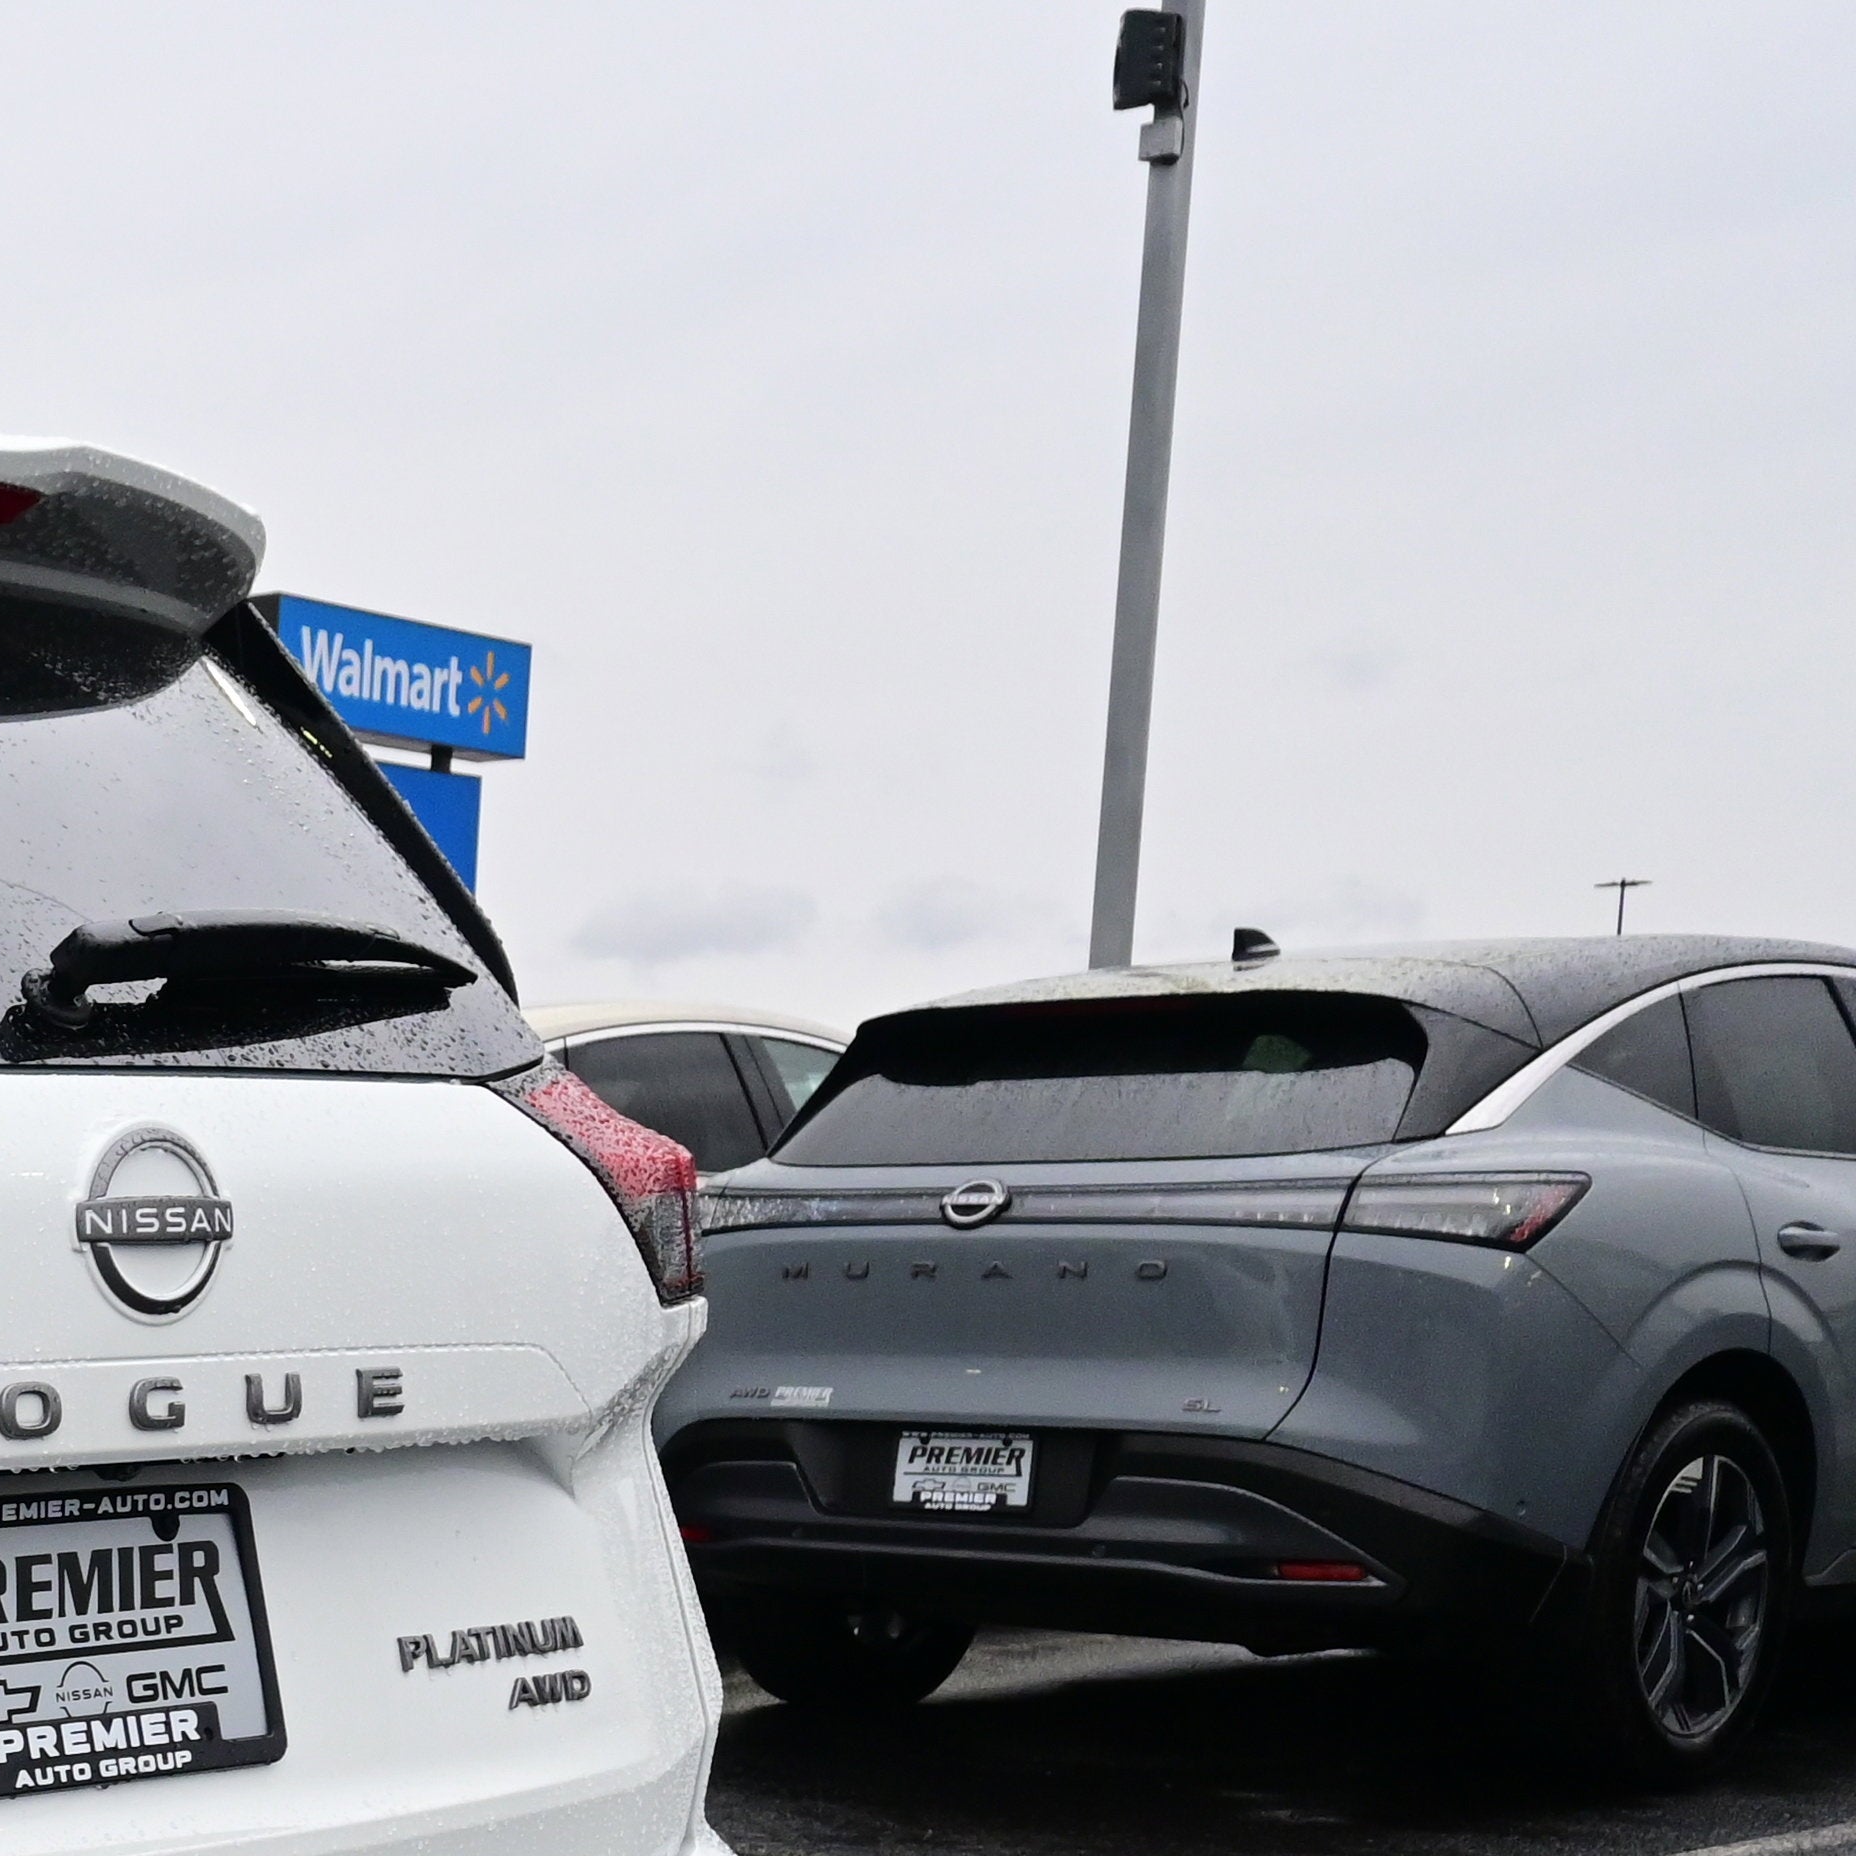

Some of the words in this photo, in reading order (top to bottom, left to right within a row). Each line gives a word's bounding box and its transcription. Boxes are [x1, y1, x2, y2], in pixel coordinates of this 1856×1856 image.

[301, 625, 463, 717] Walmart
[84, 1207, 231, 1235] NISSAN
[781, 1260, 1168, 1281] MURANO
[908, 1446, 1026, 1475] PREMIER
[920, 1491, 997, 1505] PREMIER
[977, 1482, 1017, 1493] GMC
[68, 1615, 184, 1644] GROUP
[397, 1615, 585, 1673] PLATINUM
[56, 1686, 114, 1703] NISSAN
[126, 1664, 229, 1704] GMC
[508, 1669, 592, 1710] AWD
[15, 1762, 92, 1789] AUTO
[99, 1750, 193, 1778] GROUP
